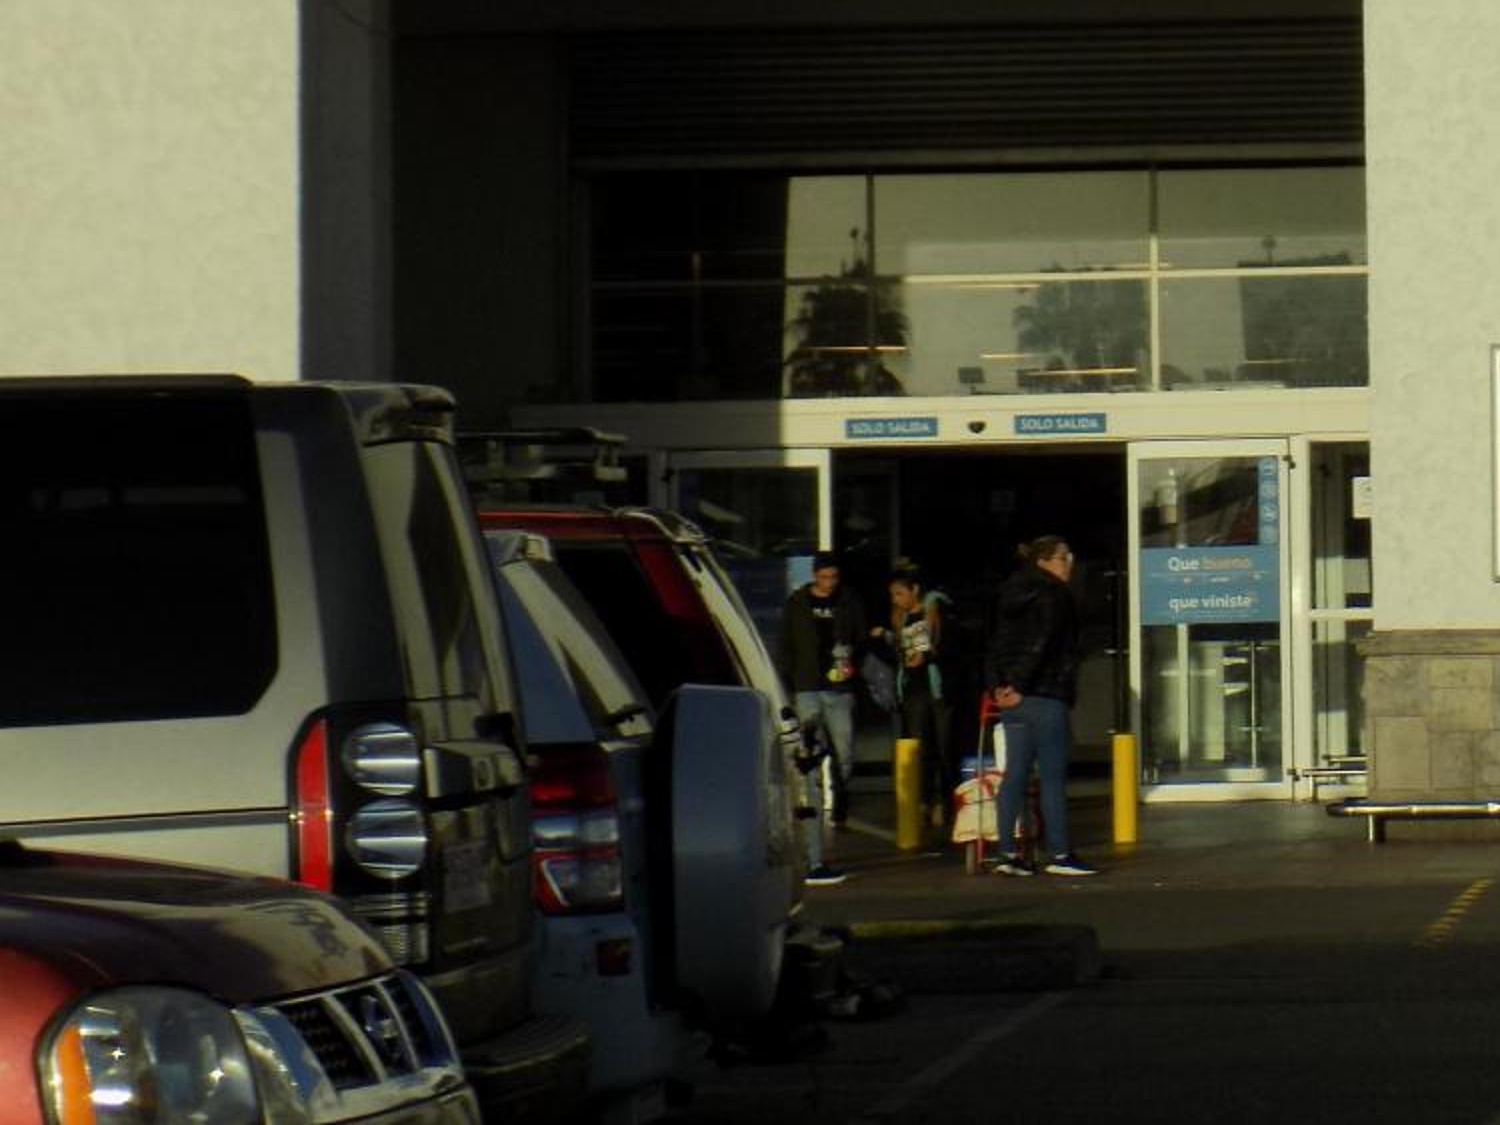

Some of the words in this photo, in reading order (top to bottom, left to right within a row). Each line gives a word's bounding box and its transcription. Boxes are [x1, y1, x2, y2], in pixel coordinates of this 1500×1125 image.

[1021, 418, 1052, 430] SOLO
[1055, 416, 1098, 429] SALIDA
[1168, 556, 1200, 571] Que
[1169, 597, 1199, 613] que
